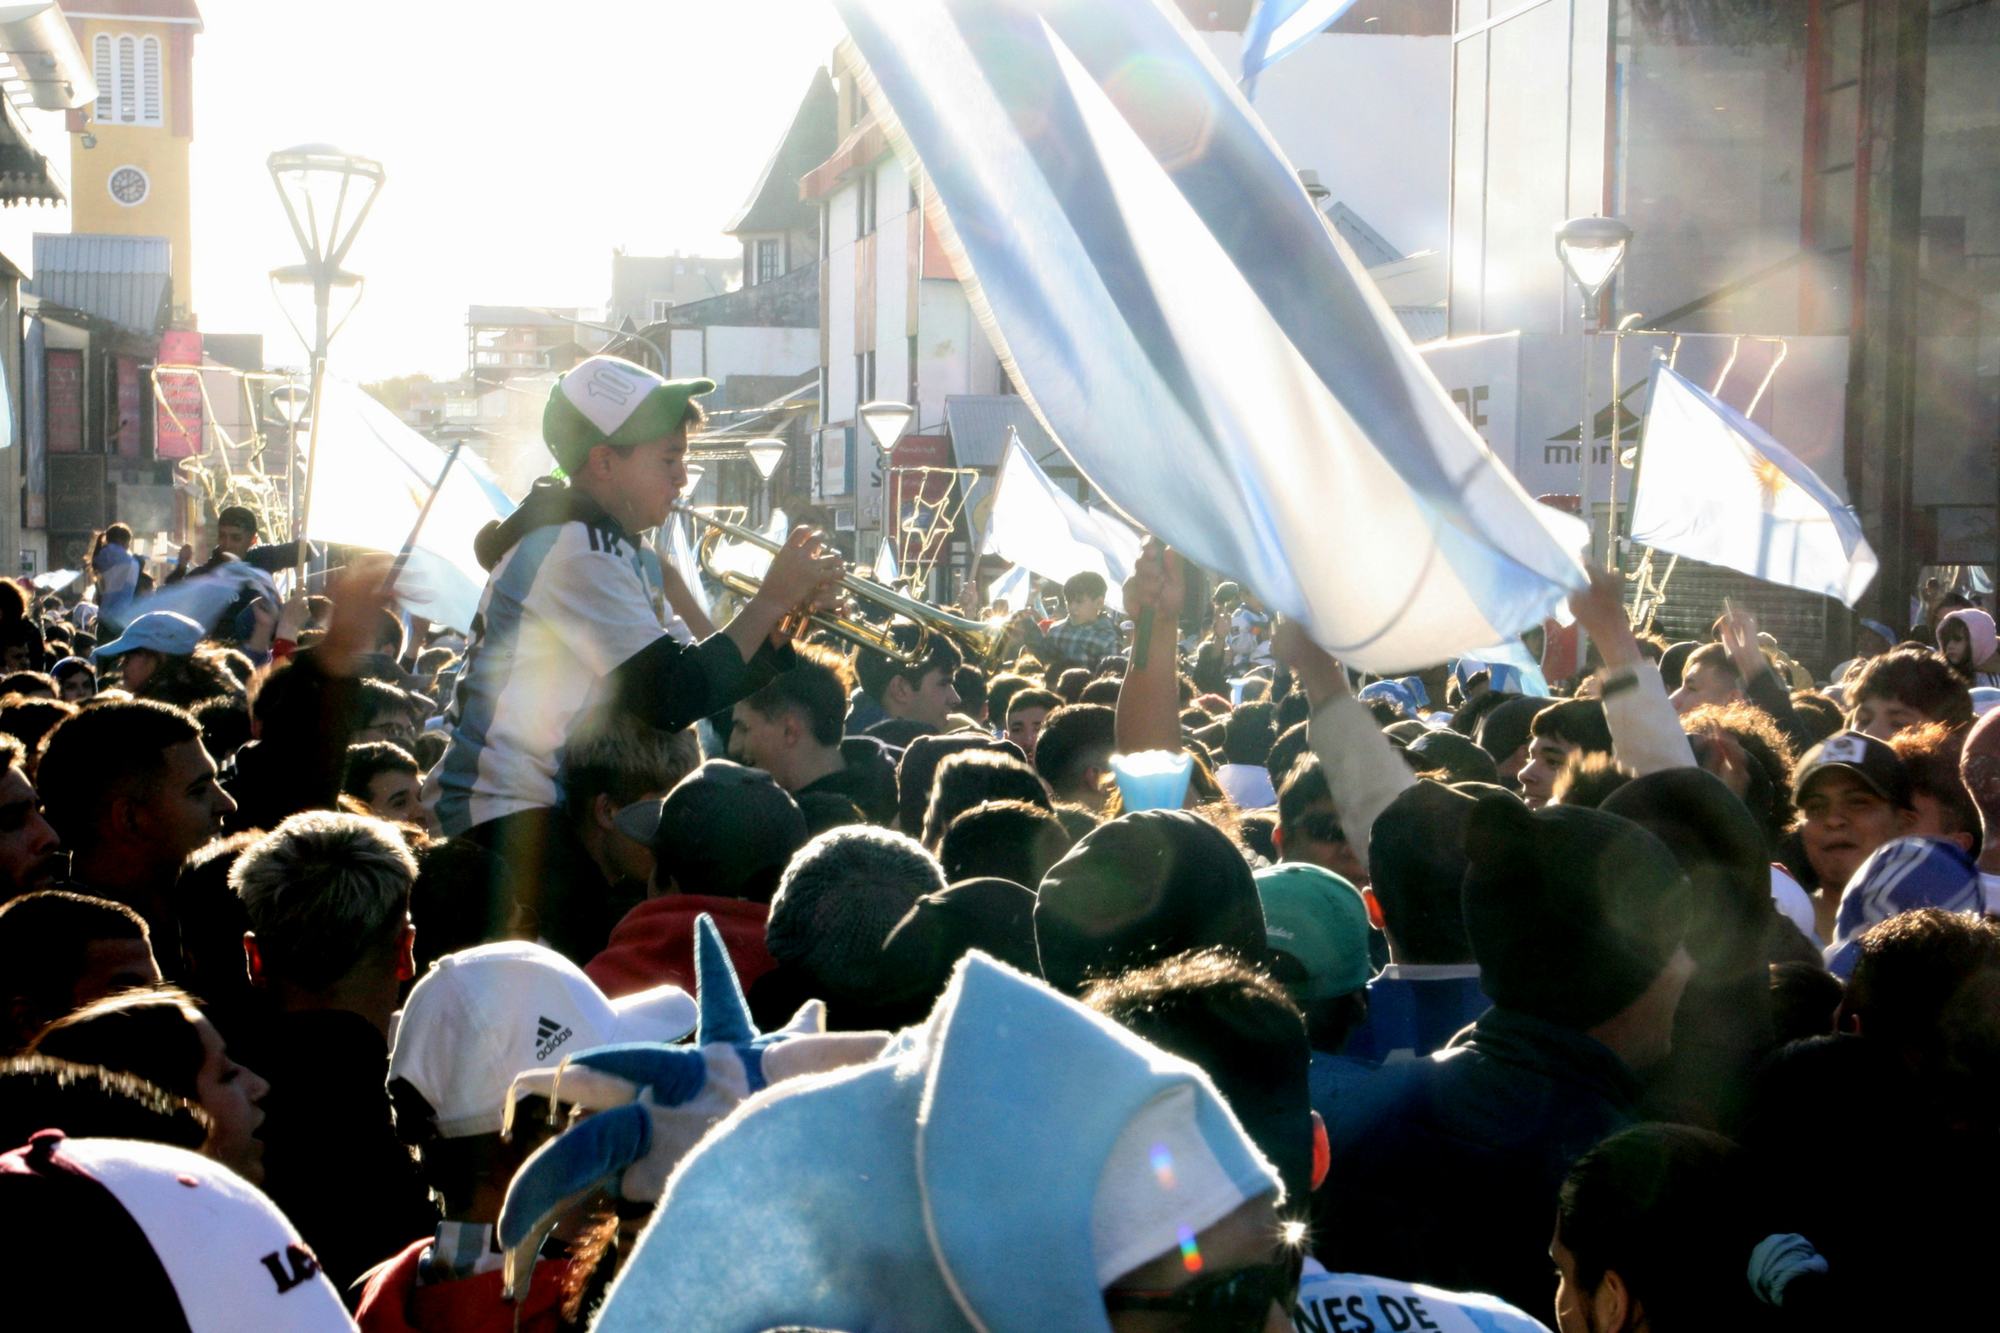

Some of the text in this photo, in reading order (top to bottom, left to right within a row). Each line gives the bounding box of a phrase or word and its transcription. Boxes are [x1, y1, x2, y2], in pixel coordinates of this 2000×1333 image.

[587, 367, 636, 406] 10
[536, 1027, 573, 1061] adidas
[1377, 1295, 1438, 1332] DE
